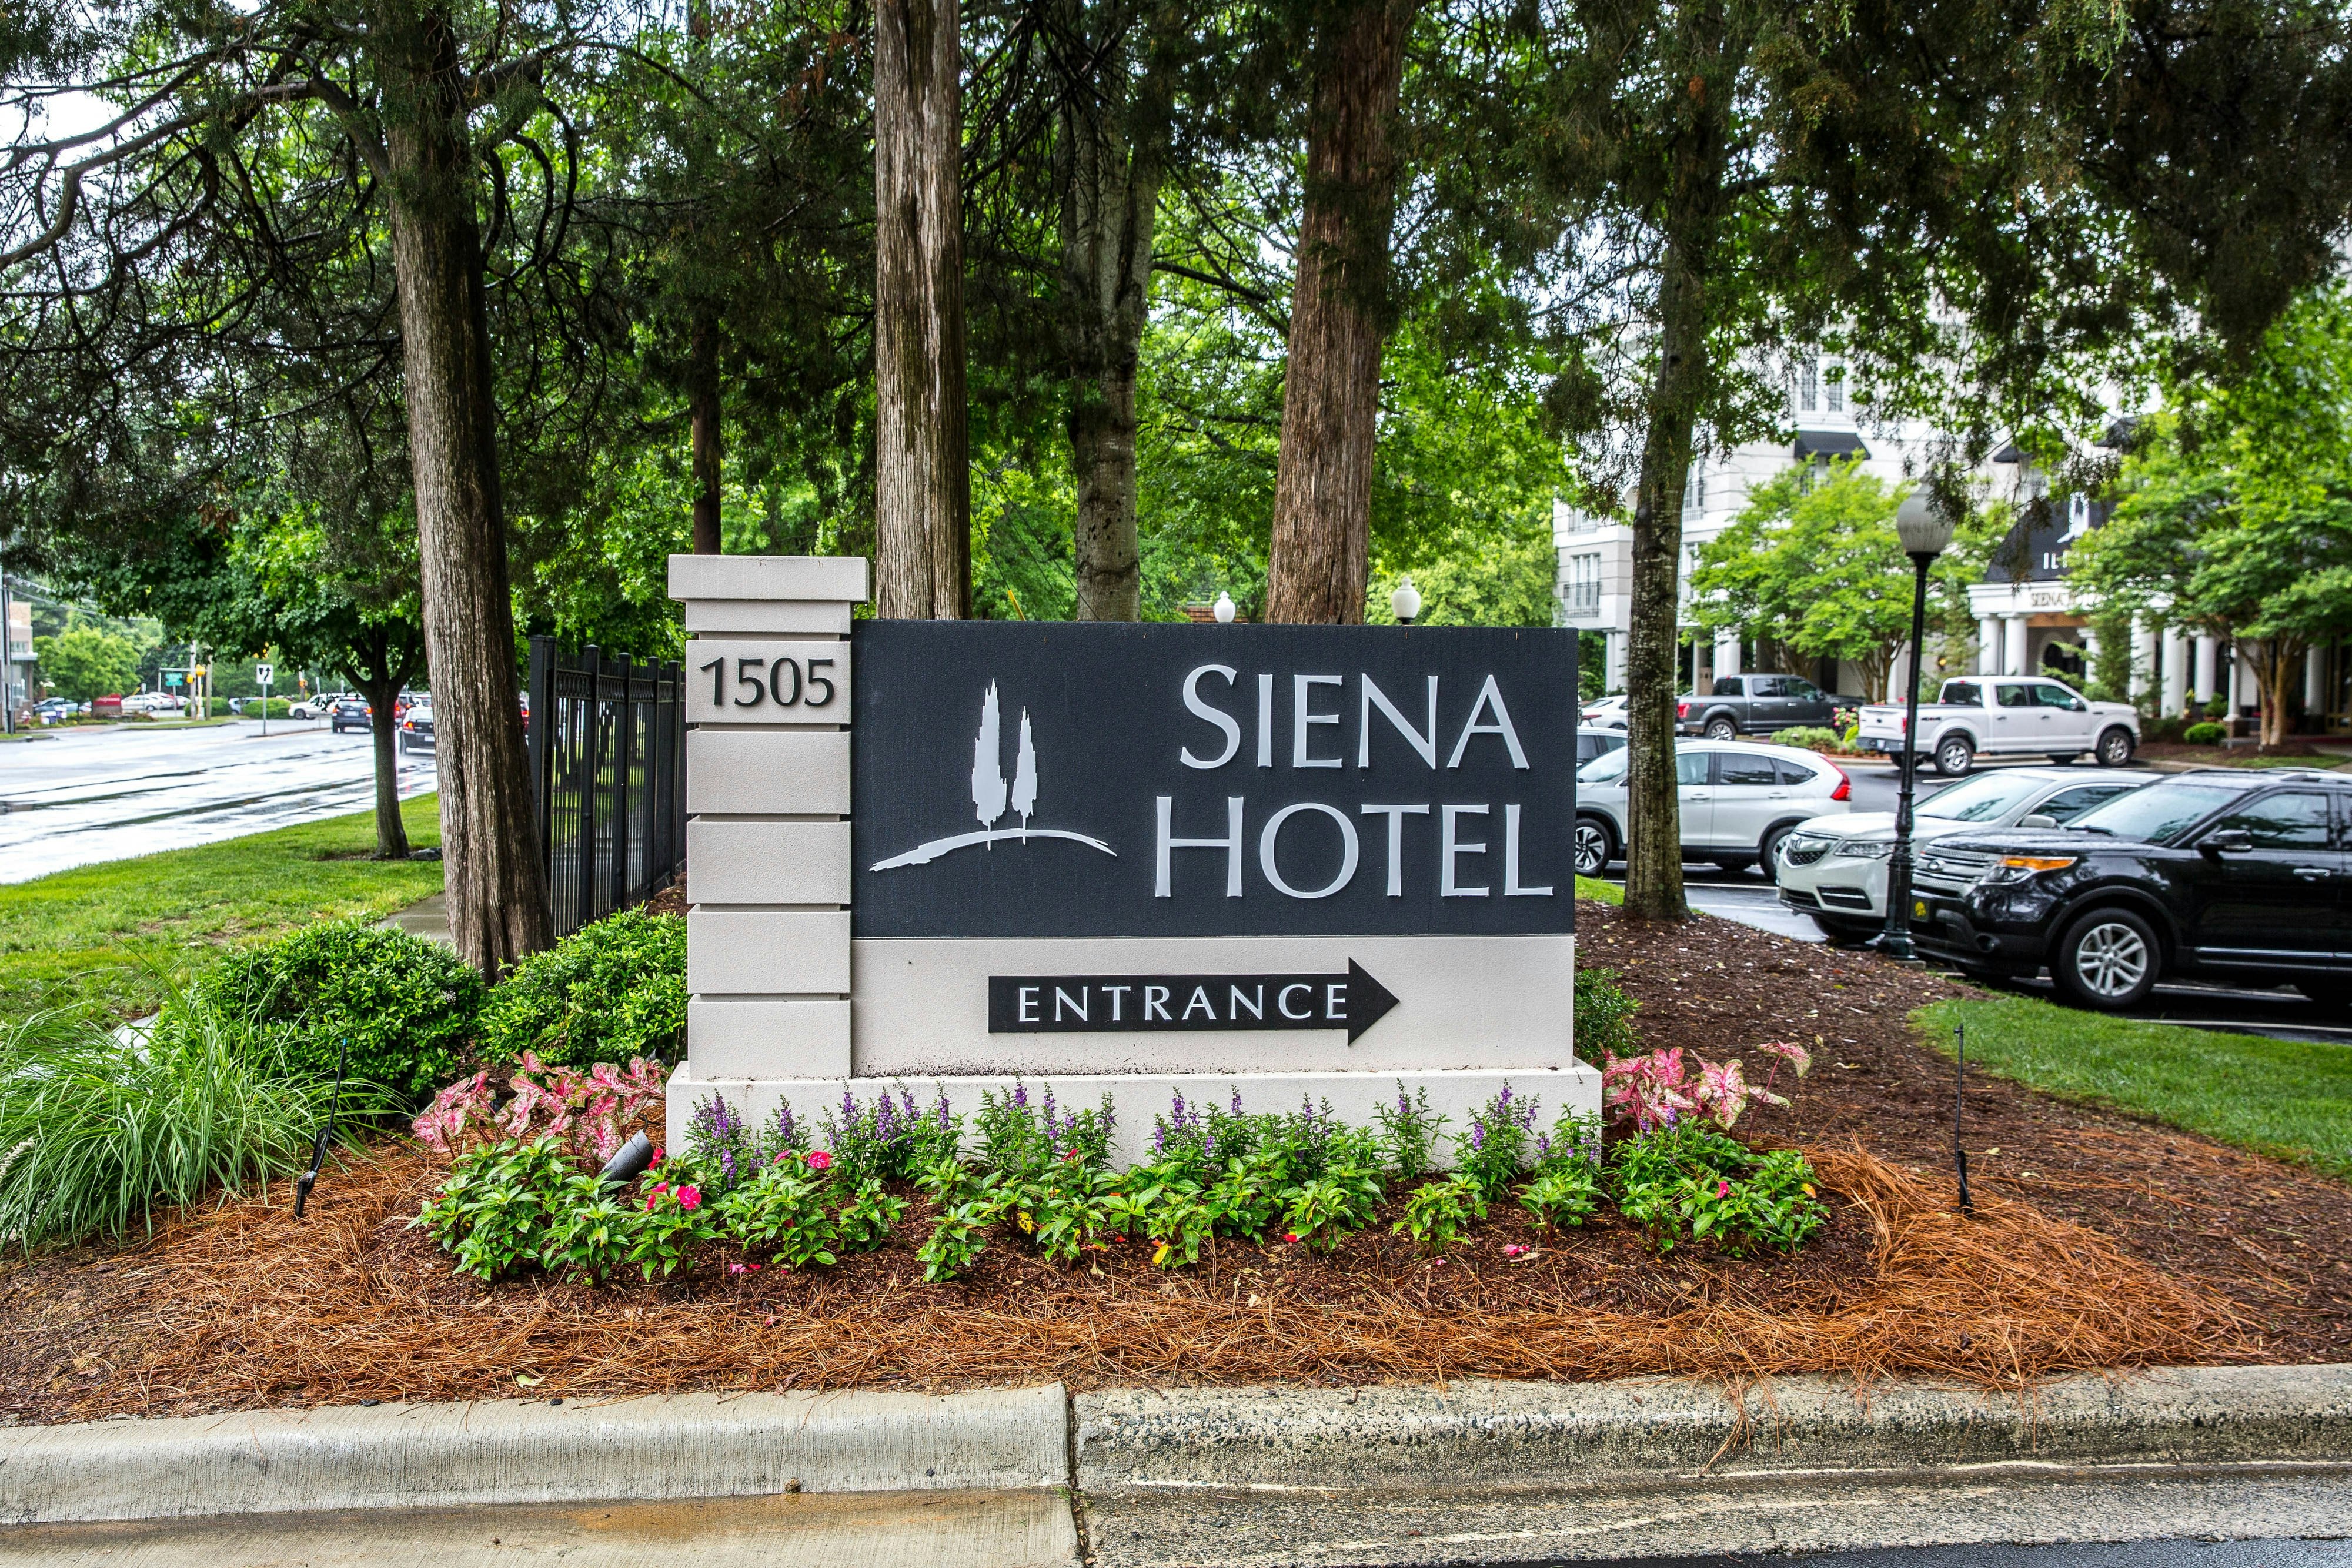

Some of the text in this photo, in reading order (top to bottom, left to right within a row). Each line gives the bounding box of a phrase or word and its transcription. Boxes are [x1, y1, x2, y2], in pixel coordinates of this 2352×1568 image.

[699, 657, 836, 708] 1505
[1180, 664, 1530, 770] SIENA
[1155, 795, 1554, 899] HOTEL
[1018, 984, 1348, 1022] ENTRANCE
